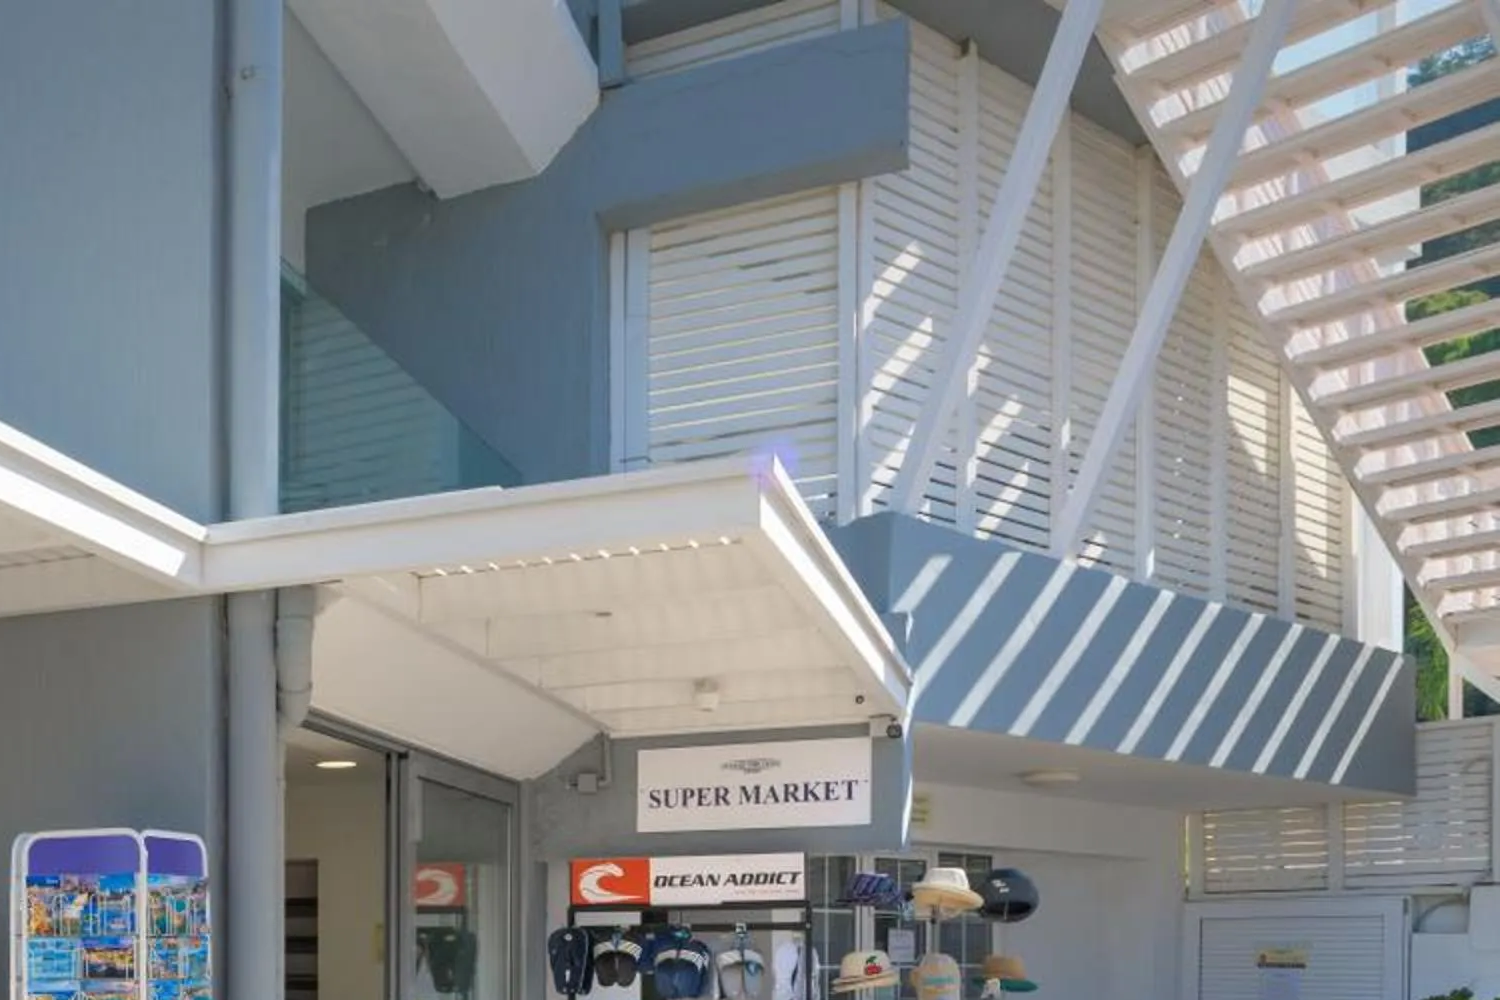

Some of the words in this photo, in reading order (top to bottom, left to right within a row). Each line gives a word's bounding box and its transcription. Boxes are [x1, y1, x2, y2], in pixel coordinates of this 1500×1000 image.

[648, 785, 731, 809] SUPER
[739, 779, 859, 806] MARKET
[653, 873, 719, 889] OCEAN
[723, 870, 802, 887] ADDICT
